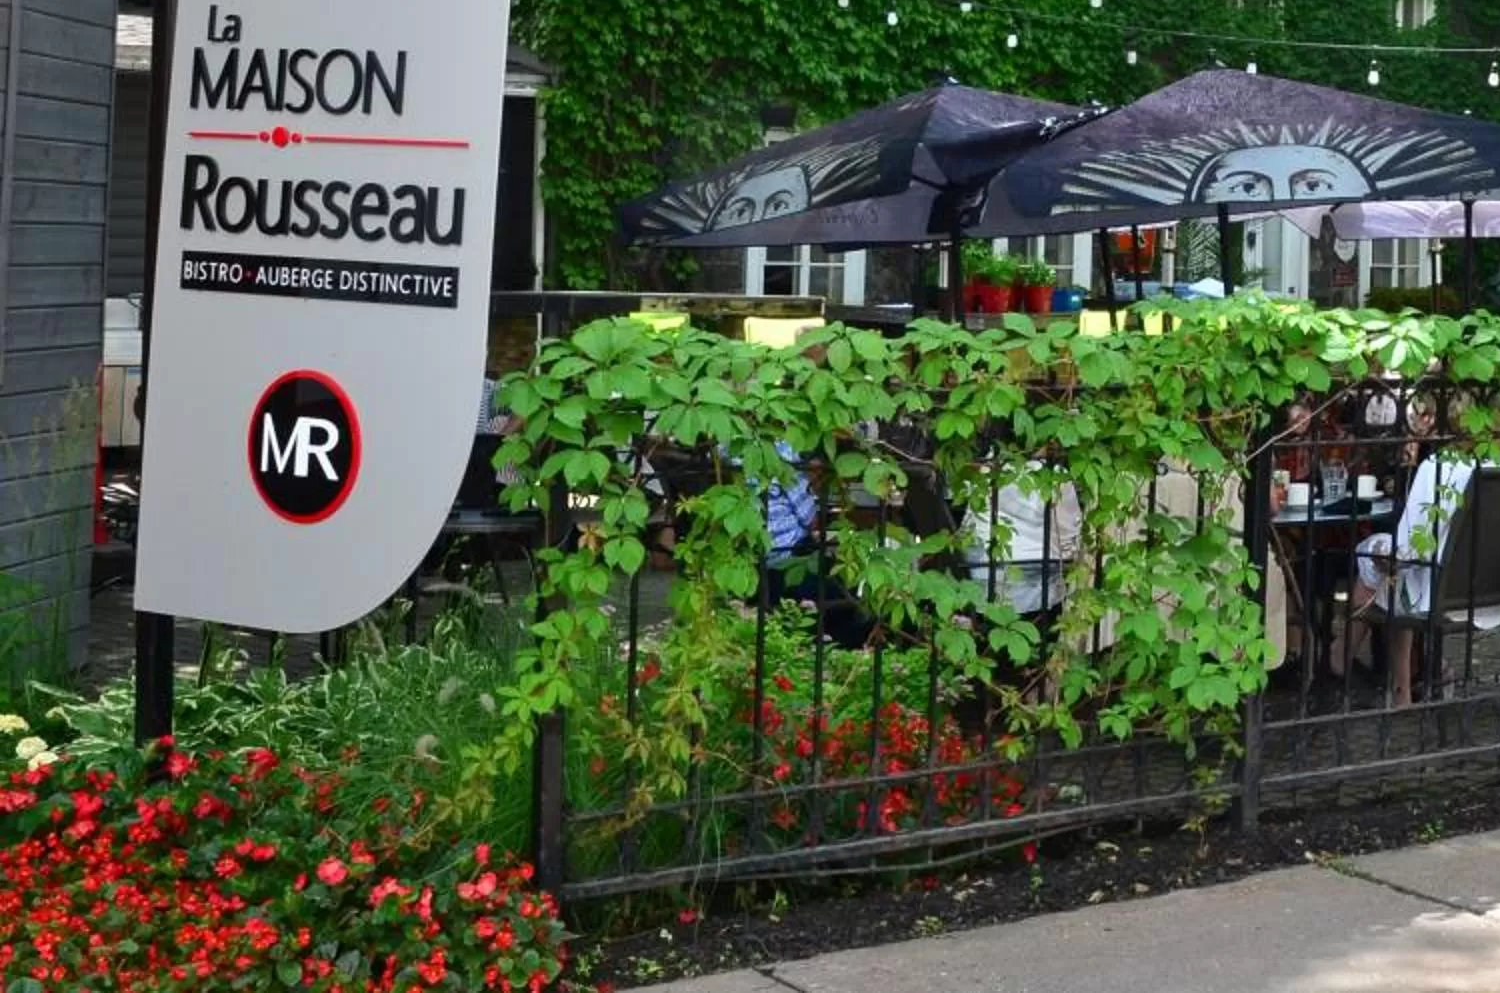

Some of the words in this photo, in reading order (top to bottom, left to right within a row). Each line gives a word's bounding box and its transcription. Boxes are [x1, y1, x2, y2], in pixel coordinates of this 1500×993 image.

[206, 5, 242, 43] La
[189, 47, 407, 116] MAISON
[180, 154, 465, 247] Rousseau
[183, 260, 243, 284] BISTRO
[254, 266, 334, 290] AUBERGE
[338, 271, 453, 298] DISTINCTIVE
[259, 411, 340, 482] MR
